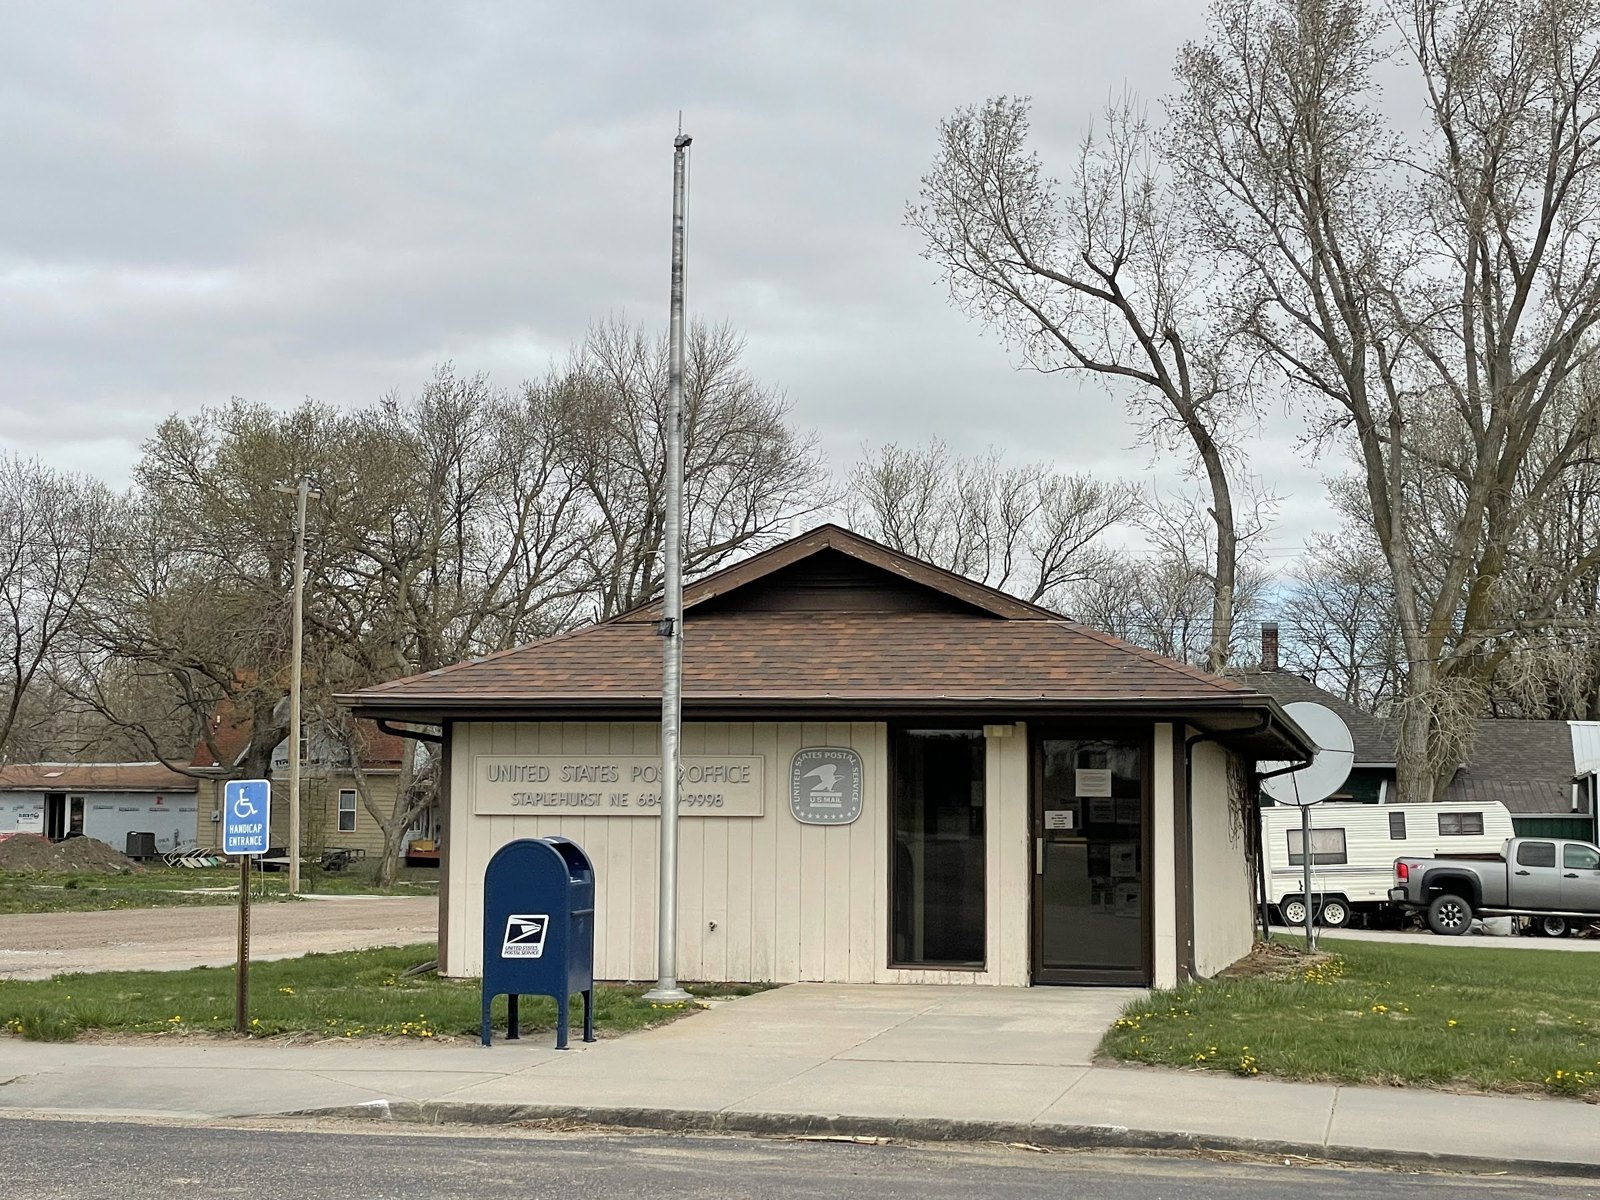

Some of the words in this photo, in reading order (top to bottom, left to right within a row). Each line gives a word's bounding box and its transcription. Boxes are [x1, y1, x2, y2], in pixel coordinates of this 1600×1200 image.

[796, 752, 822, 766] STATES
[824, 752, 857, 766] POSTAL
[487, 764, 550, 783] UNITED
[559, 764, 619, 783] STATES
[687, 765, 750, 783] OFFICE
[793, 768, 801, 803] UNITED
[511, 791, 603, 807] STAPLEHURST
[609, 793, 629, 807] NE
[229, 823, 263, 835] HANDICAP
[228, 835, 263, 847] ENTRANCE
